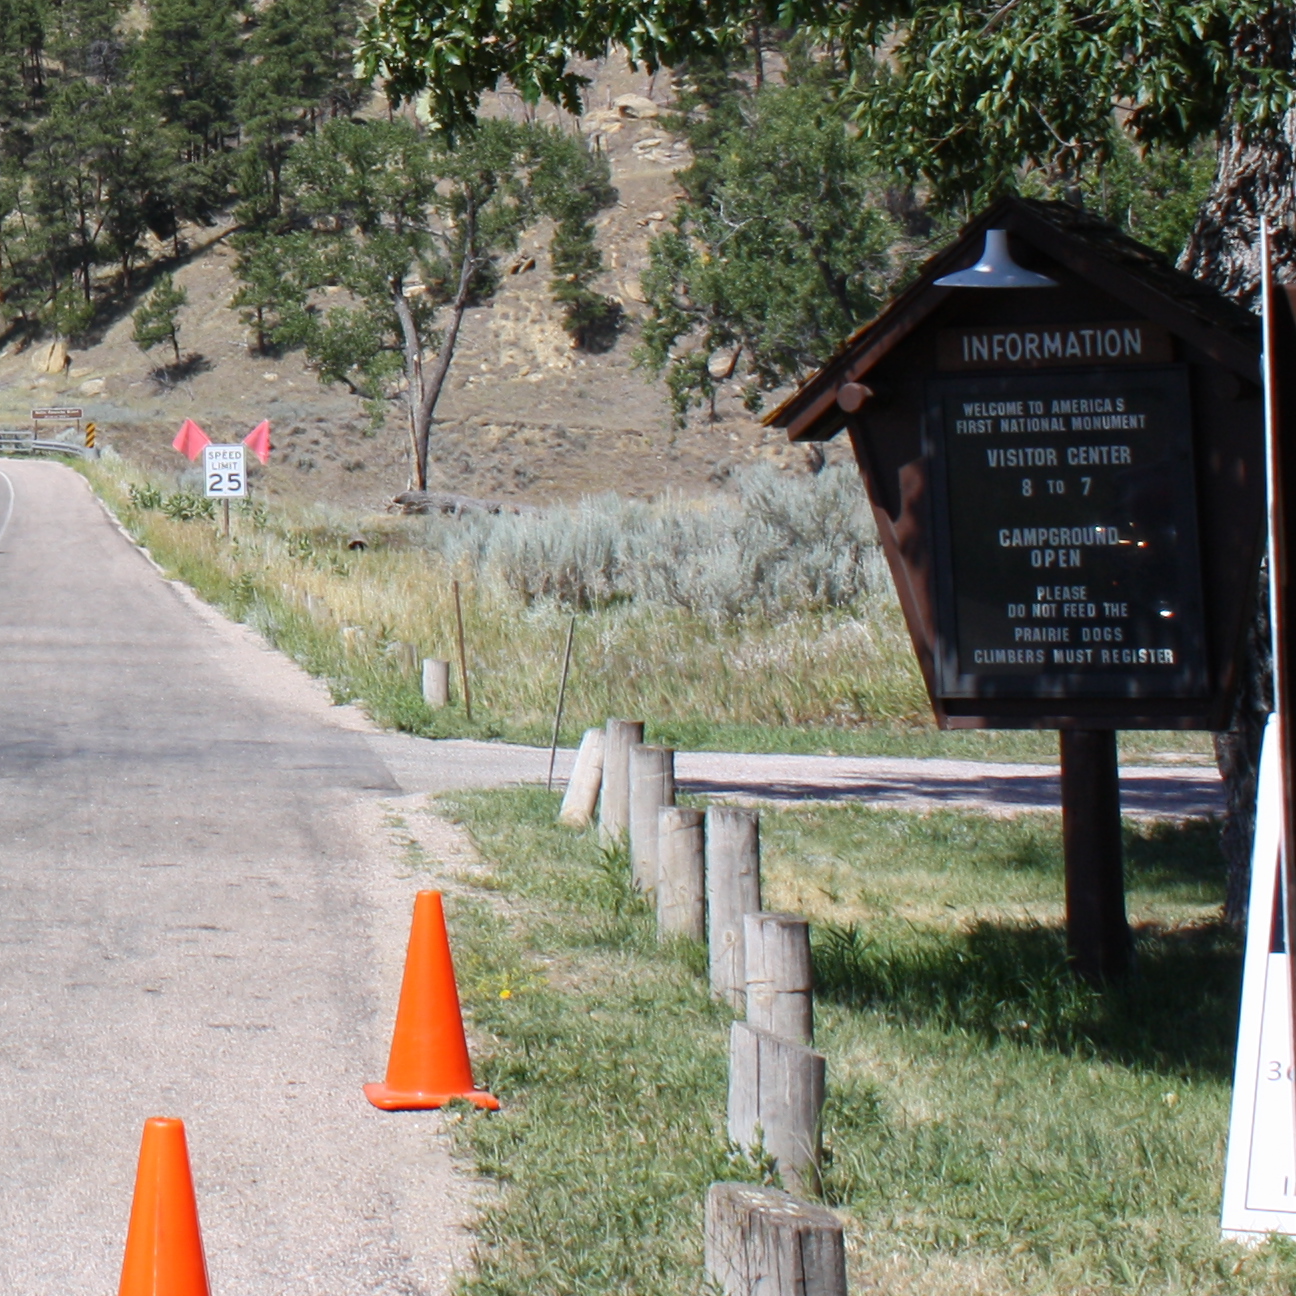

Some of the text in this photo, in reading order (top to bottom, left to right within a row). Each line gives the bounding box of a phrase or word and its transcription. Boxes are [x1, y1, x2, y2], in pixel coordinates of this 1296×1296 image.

[963, 328, 1142, 361] INFORMATION
[963, 402, 1023, 417] WELCOME
[1028, 401, 1044, 415] TO
[956, 415, 1145, 434] FIRST NATIONAL MONUMENT
[208, 451, 242, 460] SPEED
[987, 446, 1132, 468] VISITOR CENTER
[211, 462, 238, 470] LIMIT
[209, 473, 242, 491] 25
[1022, 477, 1092, 497] 8 TO 7
[999, 527, 1118, 547] CAMPGROUND
[1031, 549, 1081, 567] OPEN
[1036, 586, 1087, 601] PLEASE
[1008, 602, 1128, 618] DO NOT FEED THE
[1014, 627, 1123, 642] PRAIRIE DOGS
[974, 649, 1174, 664] CLIMBERS MUST REGISTER
